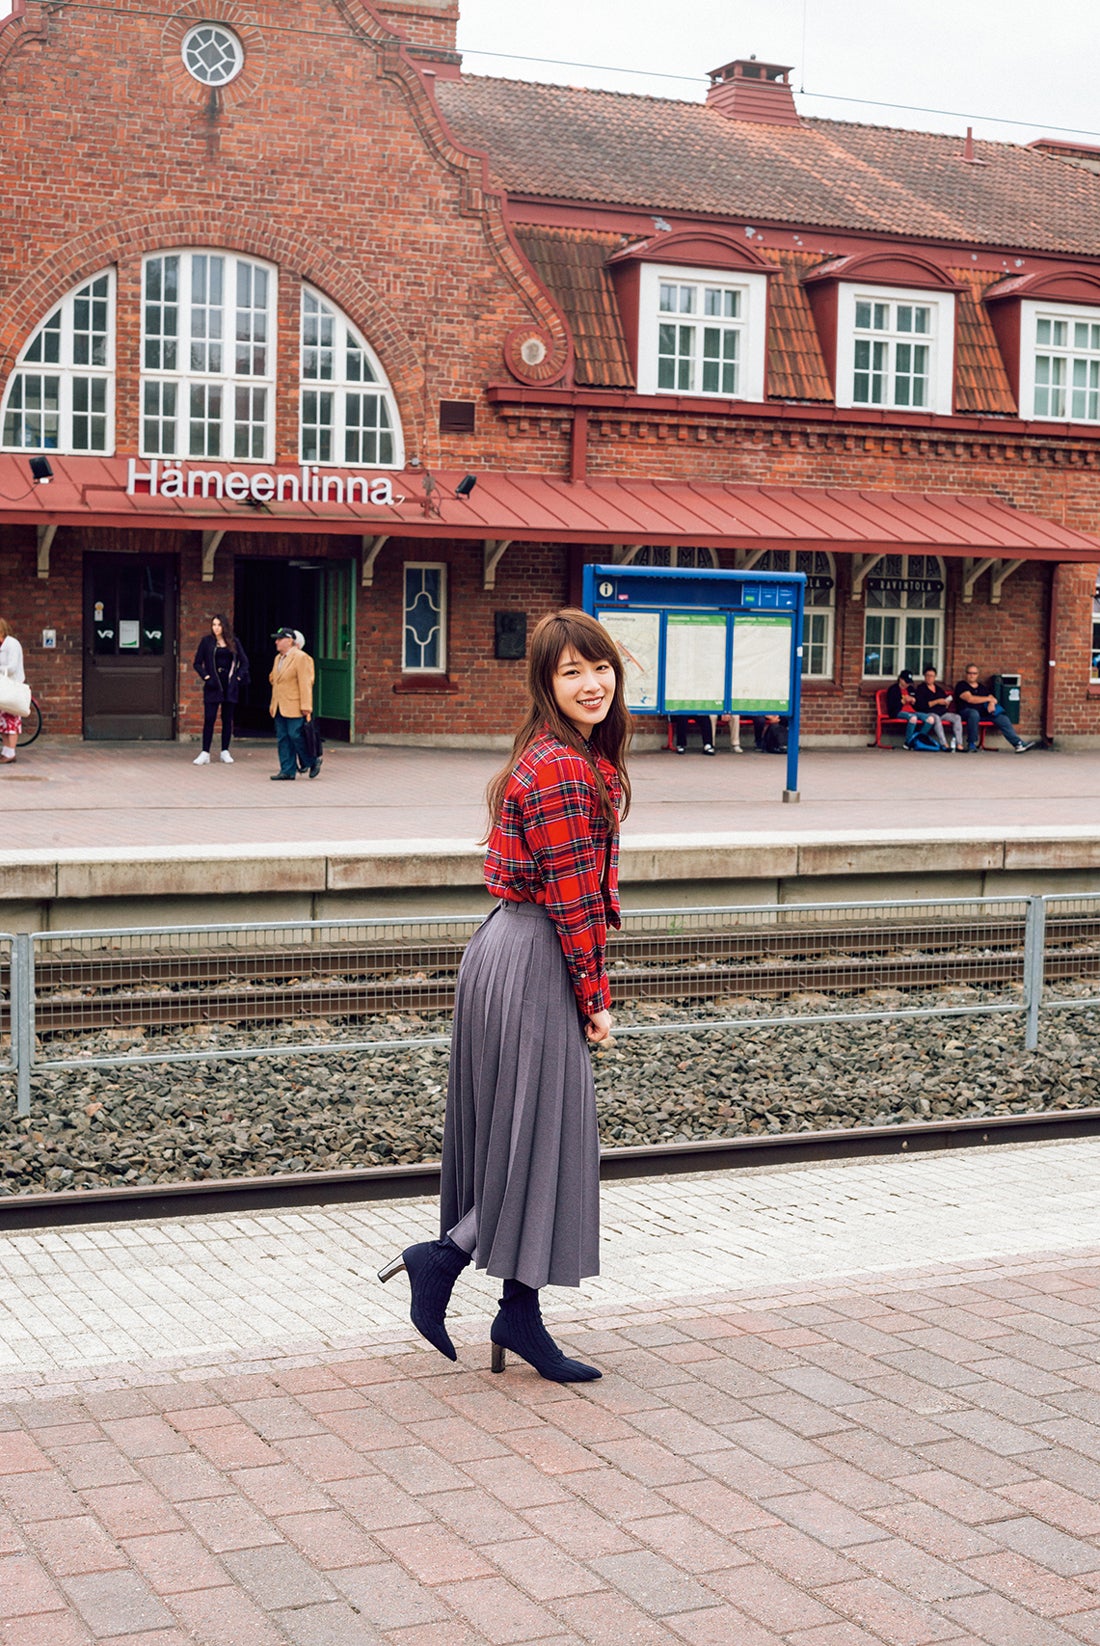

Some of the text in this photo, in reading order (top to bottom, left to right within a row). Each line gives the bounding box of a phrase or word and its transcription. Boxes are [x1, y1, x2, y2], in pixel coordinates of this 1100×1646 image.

[127, 458, 394, 504] Hämeenlinna
[880, 580, 932, 591] RAVINTOLA
[97, 629, 114, 639] VR
[145, 630, 162, 639] VR
